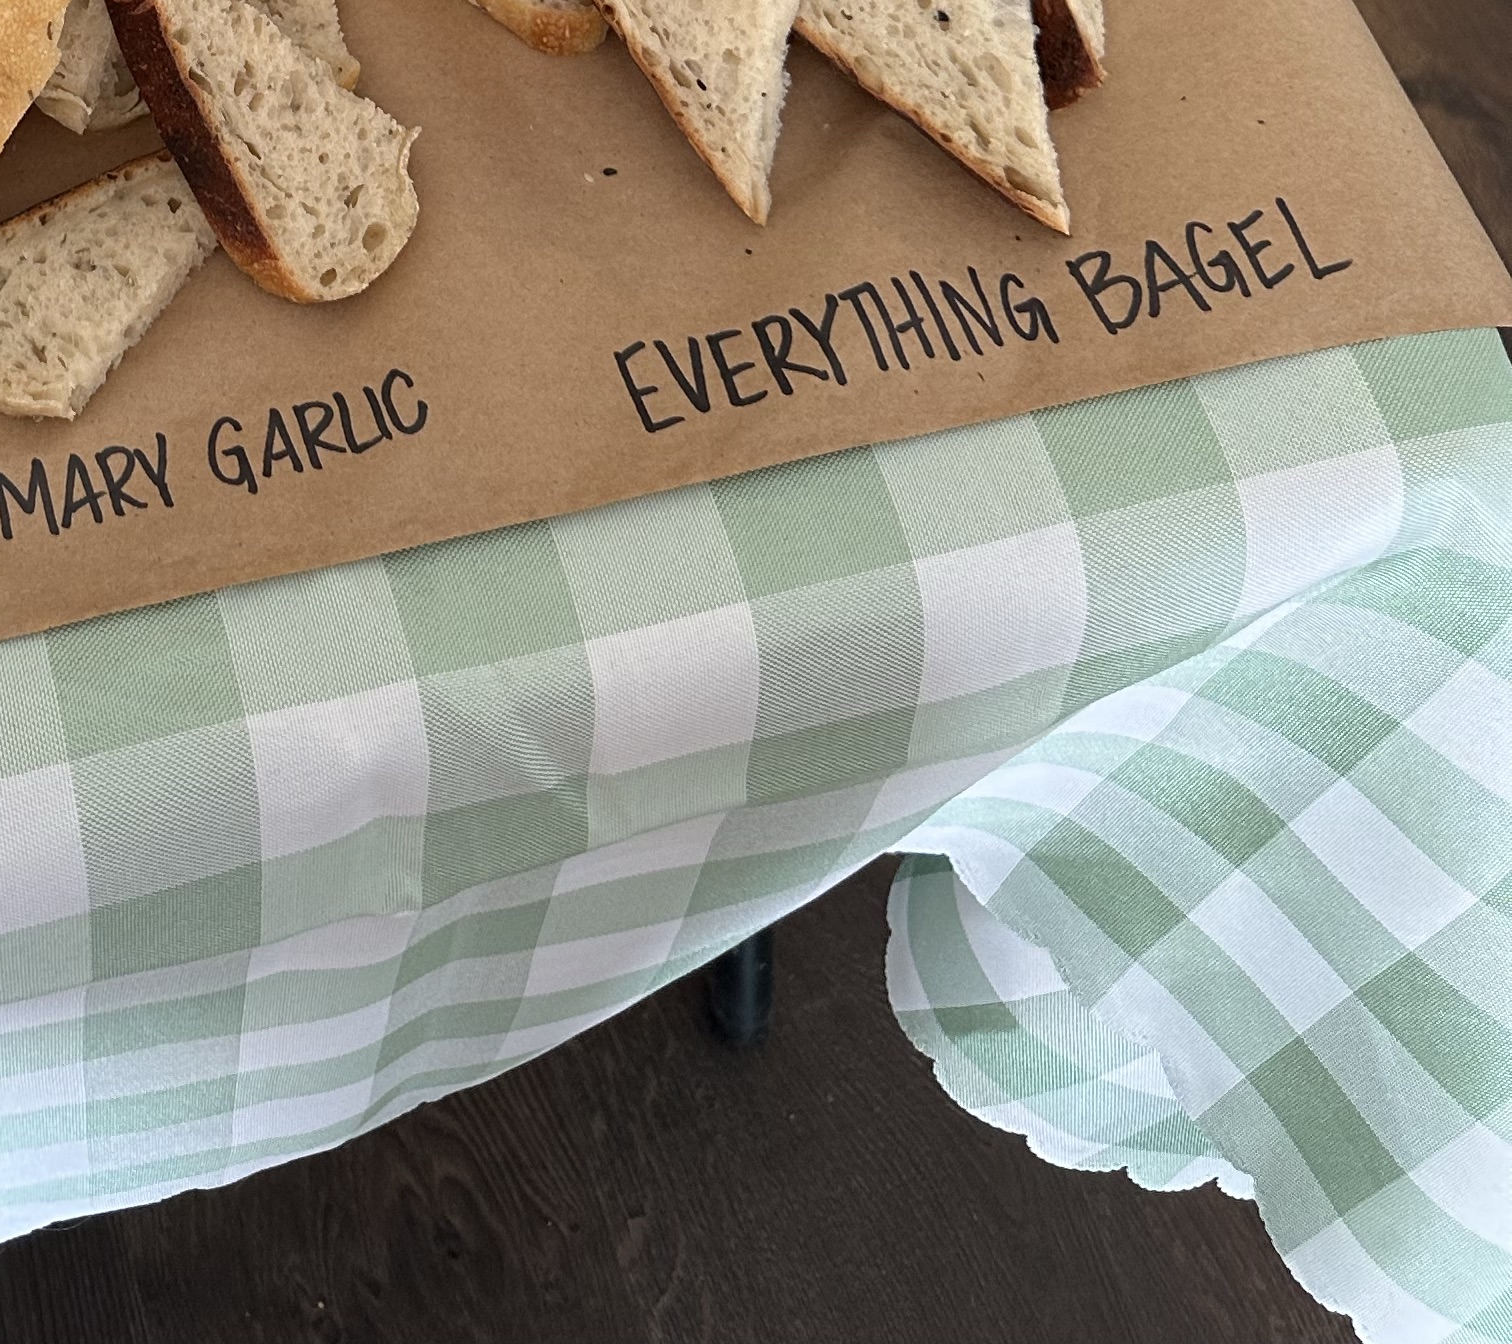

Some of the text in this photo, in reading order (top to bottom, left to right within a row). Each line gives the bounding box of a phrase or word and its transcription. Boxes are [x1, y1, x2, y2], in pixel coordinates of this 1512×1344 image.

[612, 196, 1353, 434] EVERYTHING BAGEL
[206, 368, 430, 495] GARLIC
